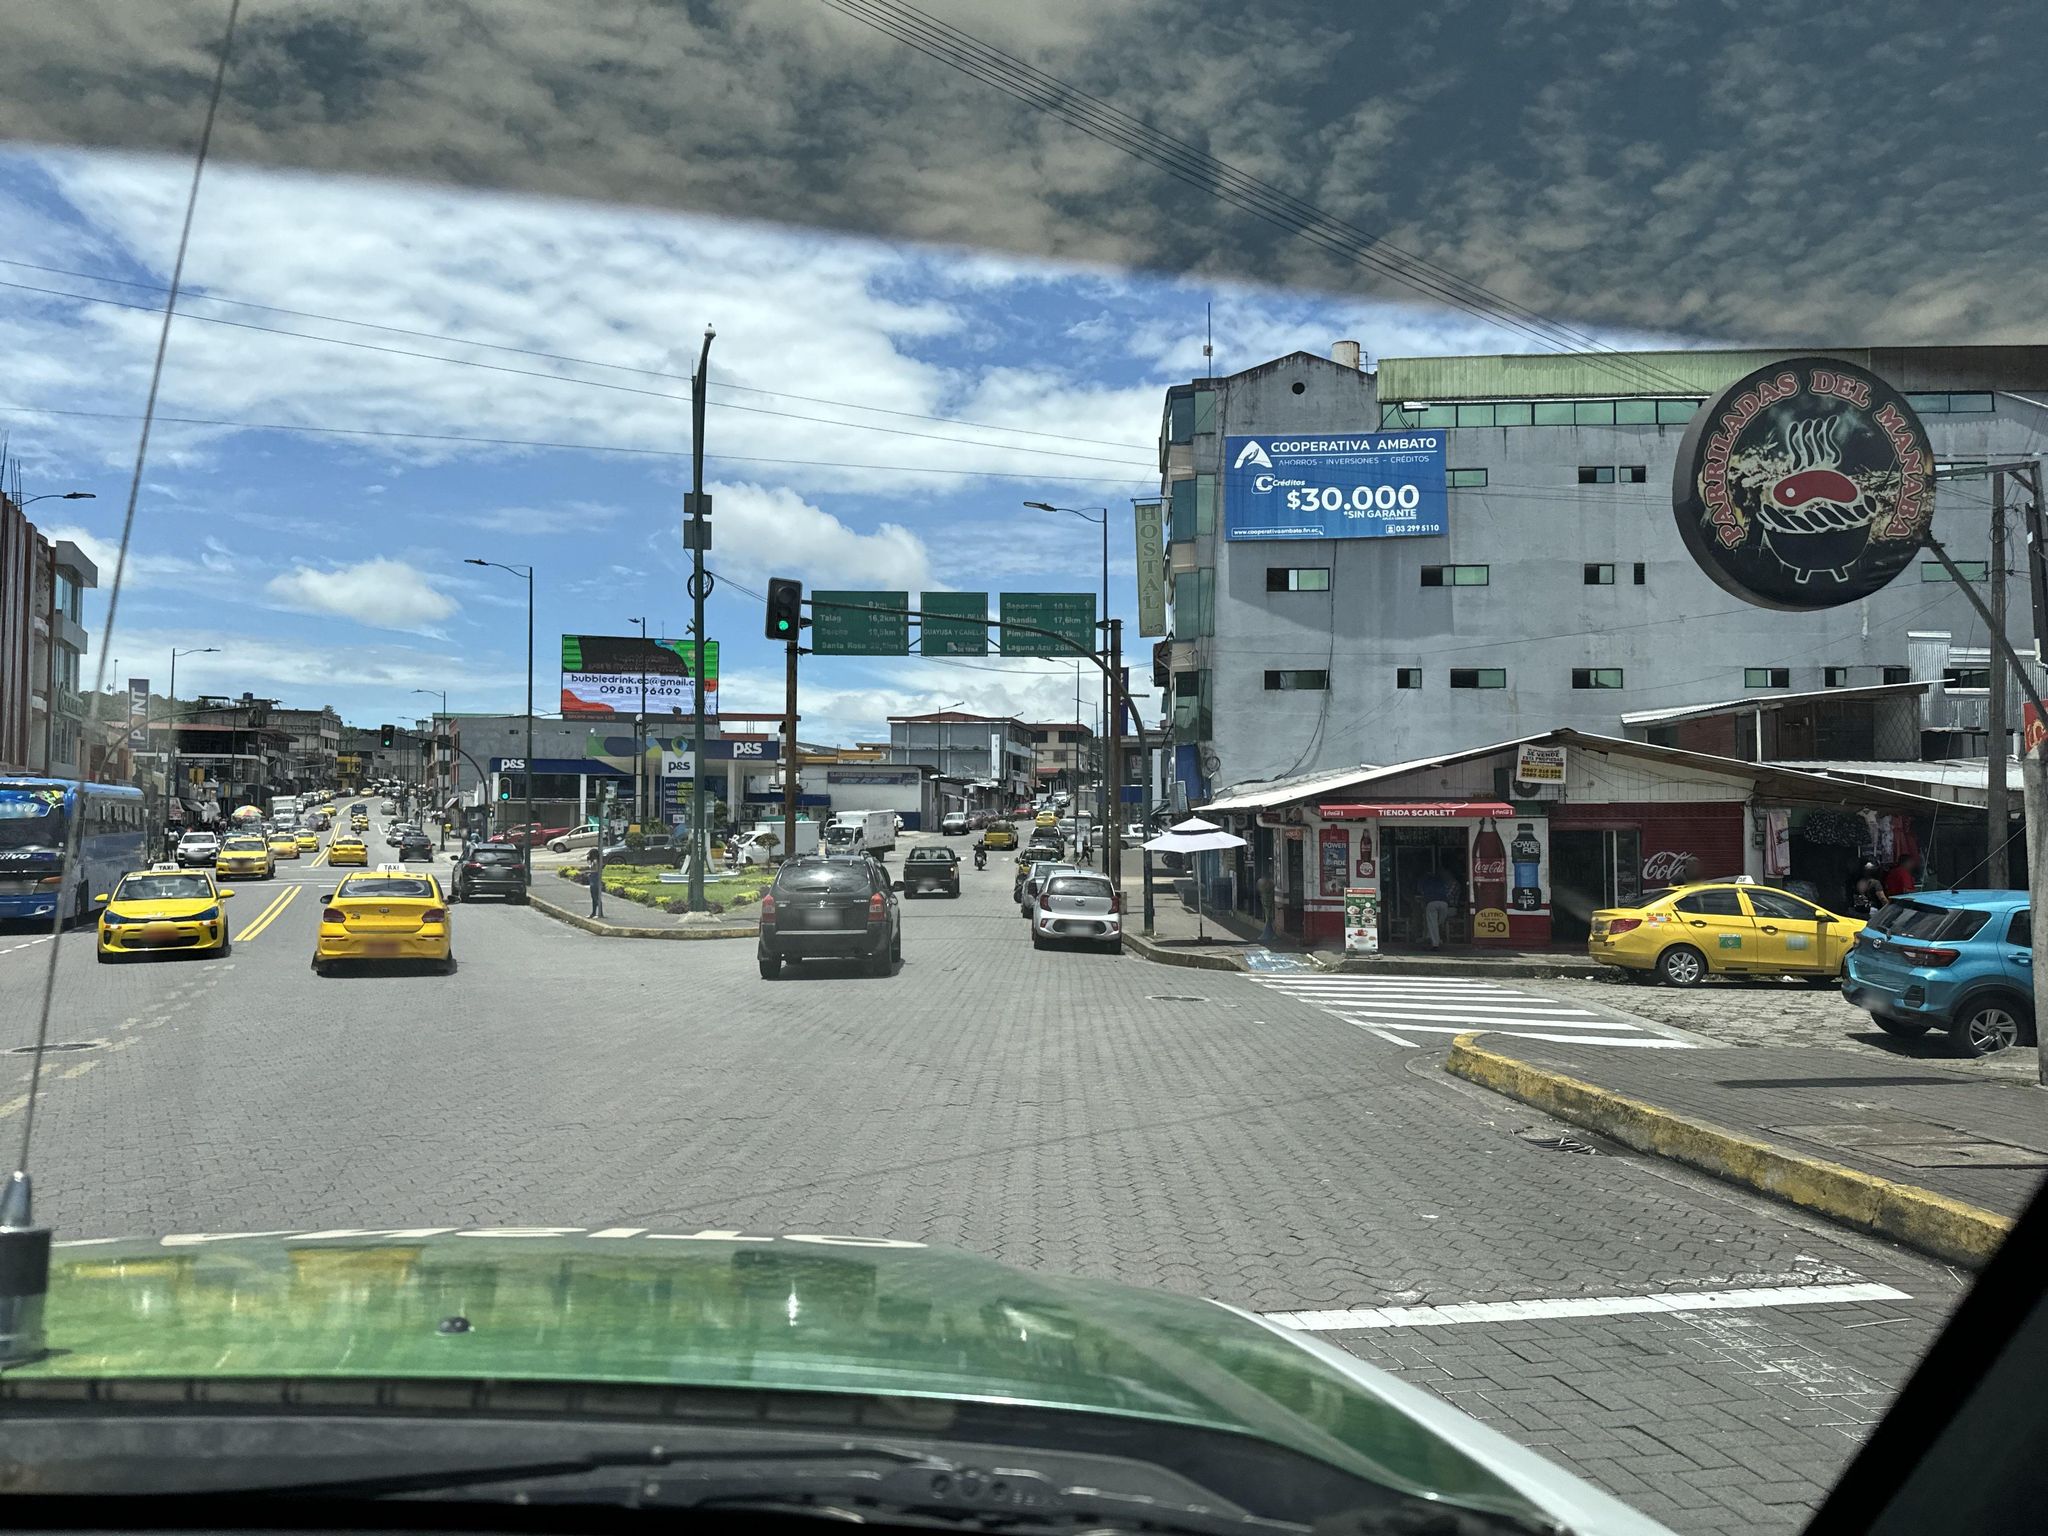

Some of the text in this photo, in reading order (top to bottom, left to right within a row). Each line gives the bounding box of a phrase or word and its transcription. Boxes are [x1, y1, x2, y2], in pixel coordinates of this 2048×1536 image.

[1271, 437, 1437, 453] COOPERATIVA AMBATO
[1279, 459, 1318, 467] AHORROS
[1326, 456, 1379, 465] INVERSIONES
[1390, 455, 1430, 464] CRÉDITOS
[1811, 371, 1871, 408] DEL
[1875, 404, 1923, 538] MANABA
[1273, 478, 1305, 487] Créditos
[1287, 484, 1420, 512] $30.000
[1367, 508, 1417, 519] GARANTE
[1396, 524, 1440, 533] 03 299 5110
[1138, 507, 1160, 610] HOSTAL
[571, 674, 711, 688] bubbledrink.ec@gmail.cm
[1412, 809, 1456, 817] SCARLETT
